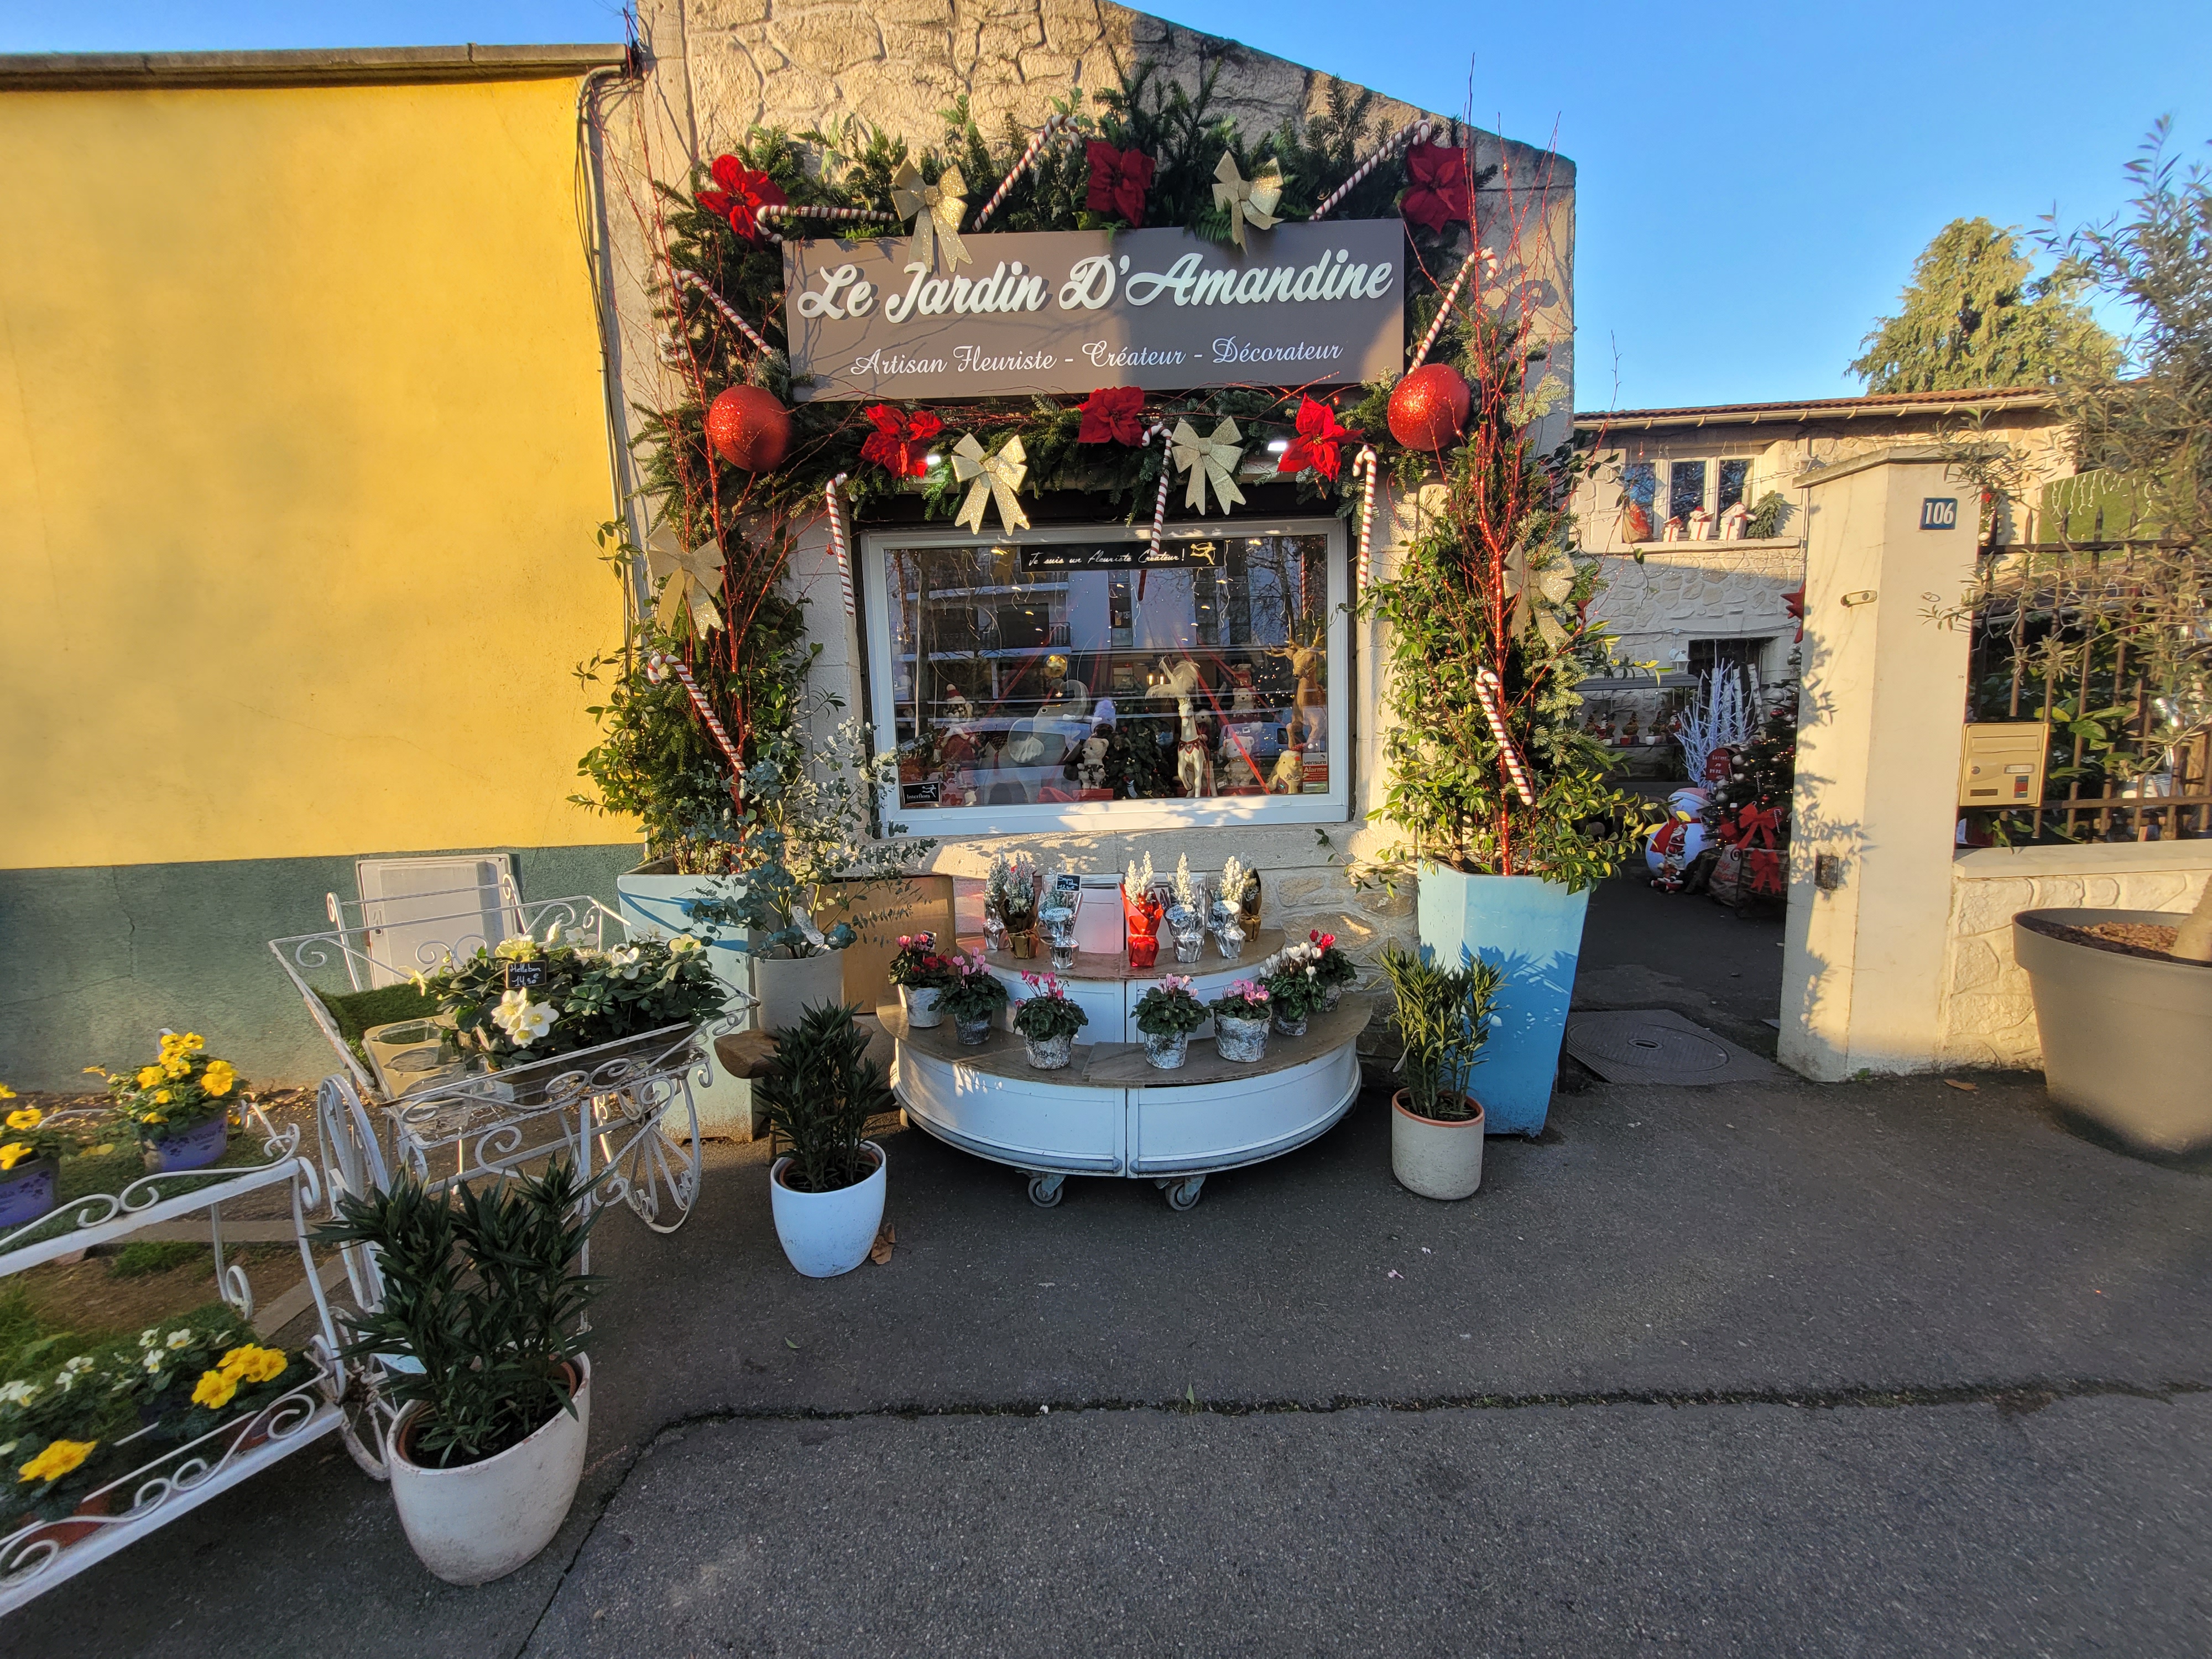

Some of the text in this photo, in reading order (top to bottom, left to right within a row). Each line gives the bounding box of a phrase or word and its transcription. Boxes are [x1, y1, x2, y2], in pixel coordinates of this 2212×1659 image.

[797, 249, 1394, 324] Le Jardin D'Amandine
[851, 348, 948, 375] Artisan
[953, 345, 1057, 373] Fleuriste
[1082, 340, 1186, 367] Créateur
[1212, 336, 1343, 364] Décorateur
[1925, 502, 1954, 524] 106
[1029, 551, 1044, 566] Je
